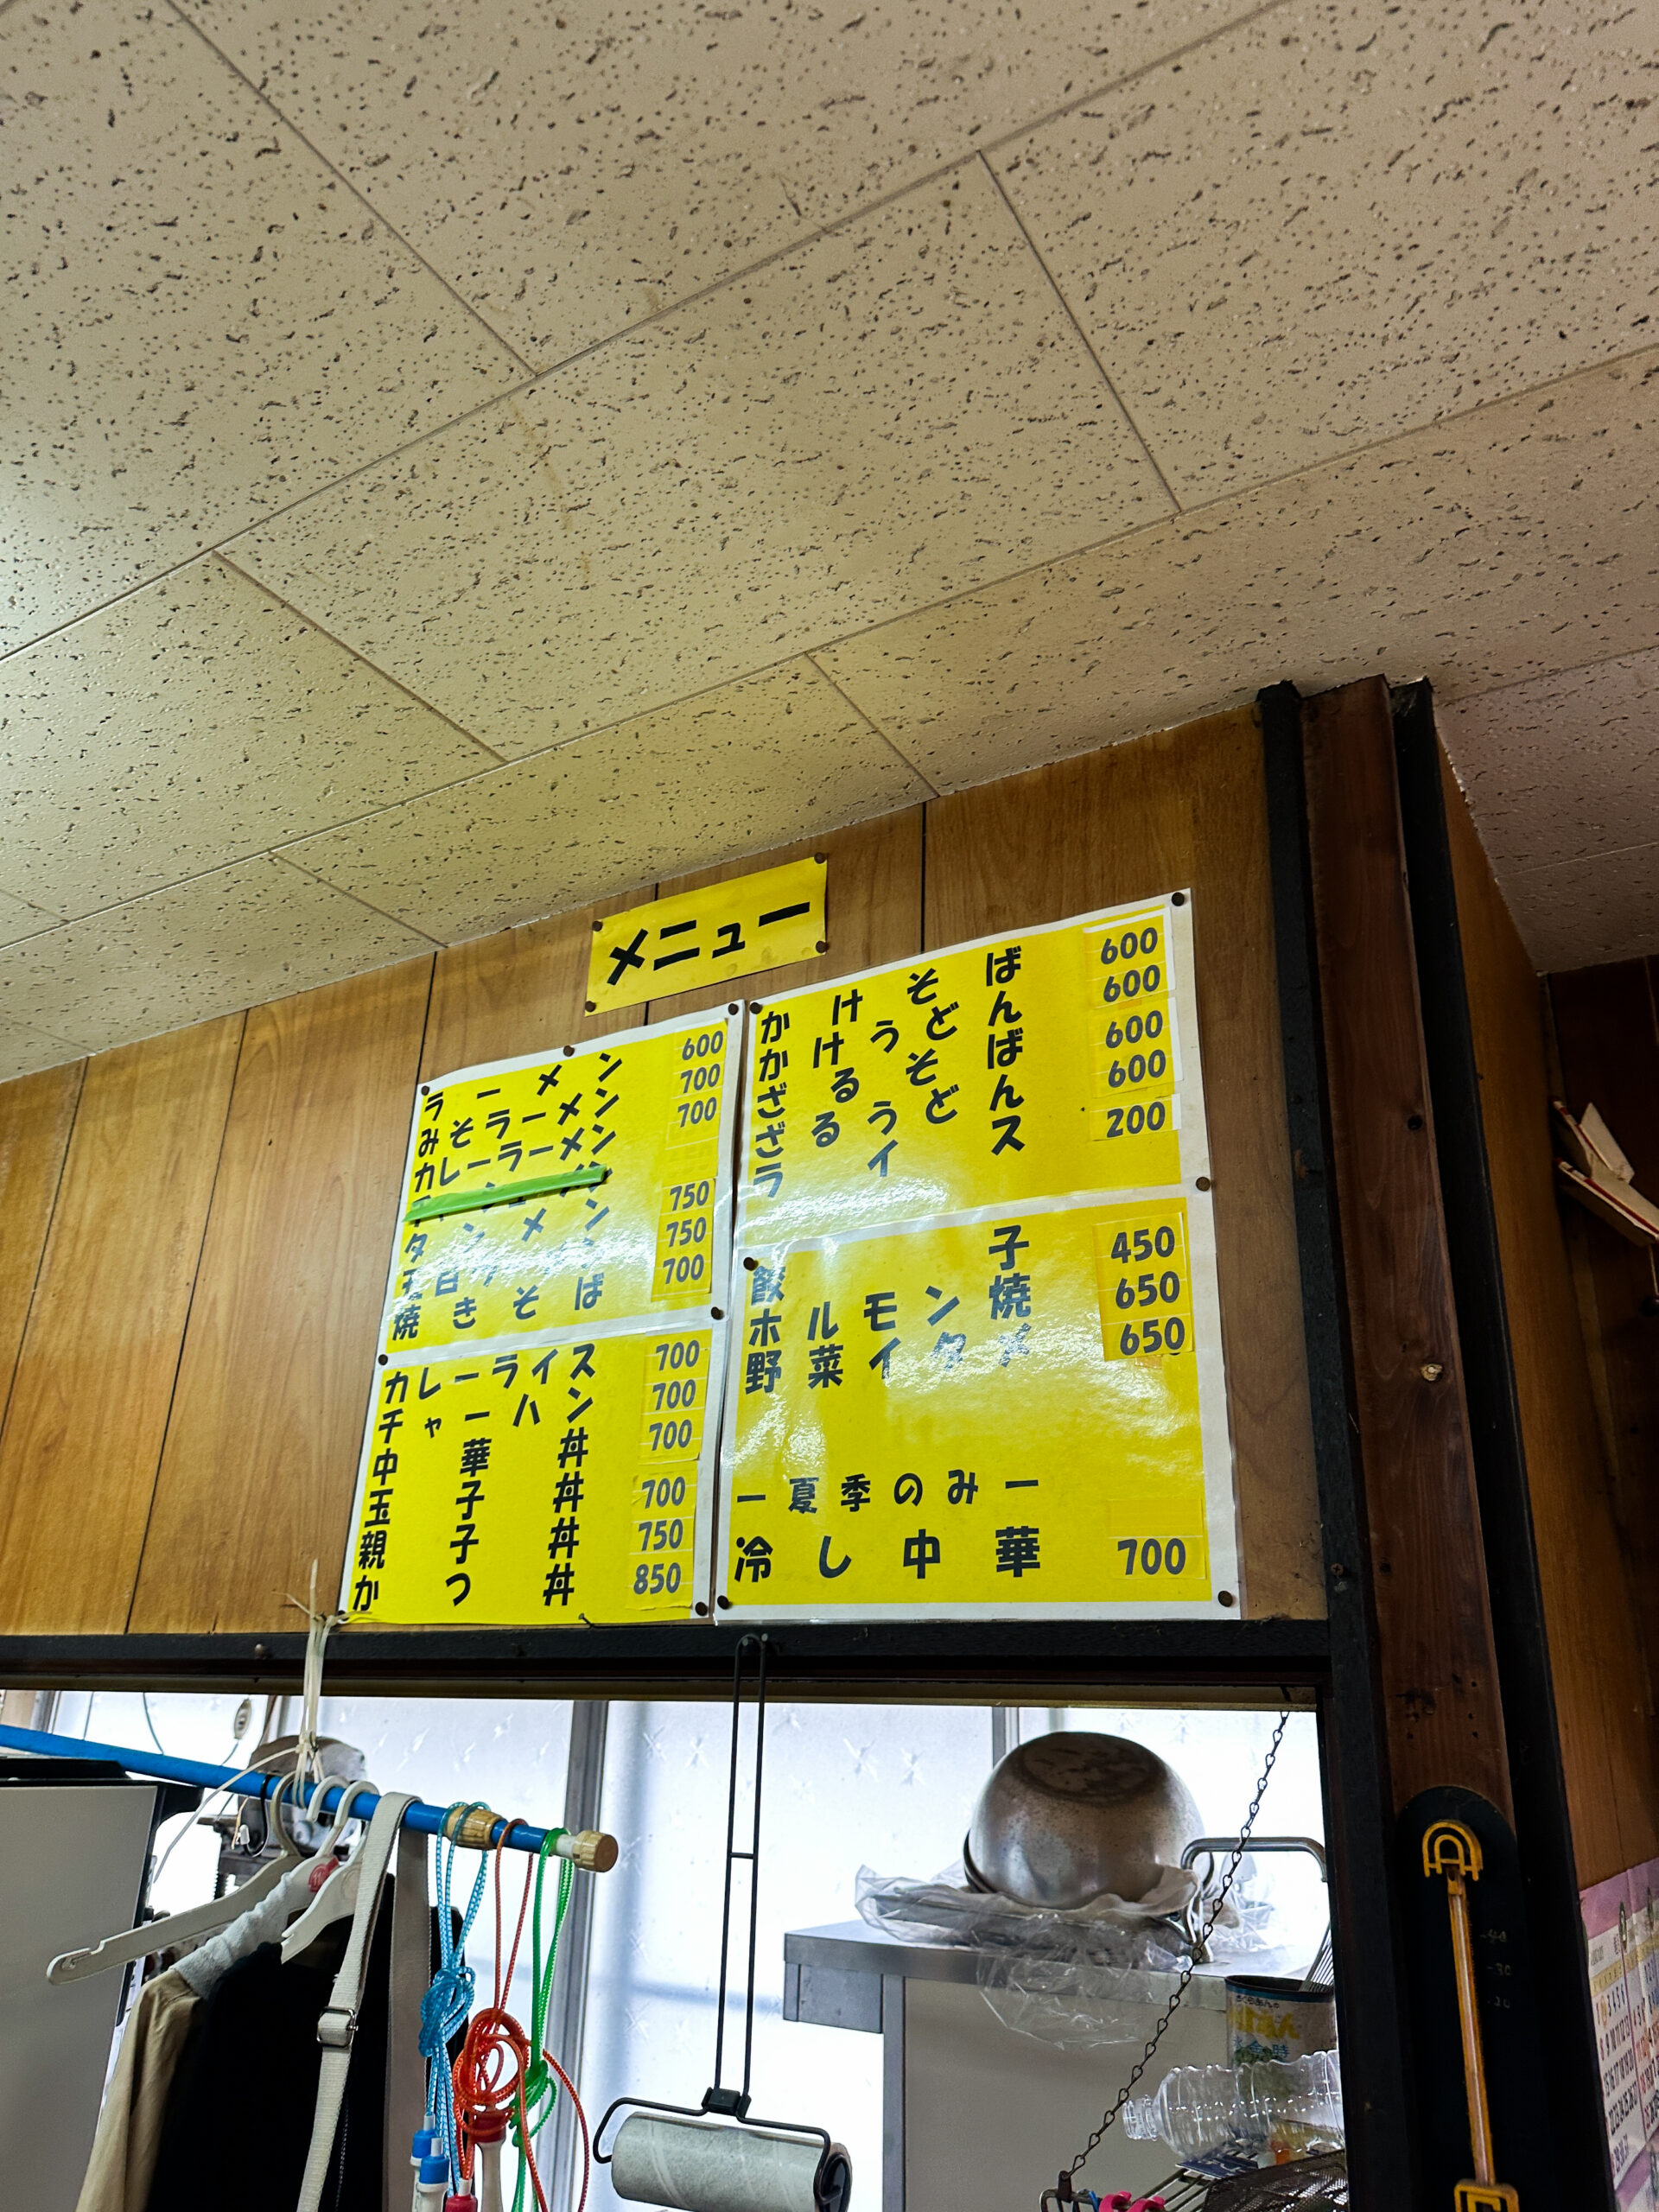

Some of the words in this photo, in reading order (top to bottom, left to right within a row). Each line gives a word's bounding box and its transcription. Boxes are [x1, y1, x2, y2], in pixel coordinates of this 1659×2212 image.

[607, 901, 810, 986] メニュー
[759, 990, 1023, 1084] かけうどん
[1103, 963, 1161, 1003] 600
[760, 946, 1022, 1045] かけそば
[1100, 926, 1159, 966] 600
[424, 1052, 622, 1121] ラーメン
[682, 1030, 724, 1062] 600
[757, 1026, 1024, 1120] ざるそば
[1104, 1009, 1164, 1049] 600
[418, 1087, 620, 1157] みそラーメン
[680, 1064, 721, 1095] 700
[754, 1074, 1025, 1160] ざるうどん
[1108, 1049, 1166, 1089] 600
[415, 1124, 616, 1193] カレーラーメン
[677, 1096, 717, 1128] 700
[753, 1114, 1026, 1198] ライス
[1105, 1101, 1166, 1139] 200
[666, 1216, 707, 1248] 750
[669, 1181, 709, 1212] 750
[1110, 1225, 1175, 1265] 450
[392, 1272, 605, 1341] 焼きそば
[663, 1254, 704, 1285] 700
[748, 1273, 1032, 1347] ホルモン焼
[1116, 1270, 1180, 1310] 650
[385, 1342, 596, 1404] カレーライス
[655, 1339, 700, 1372] 700
[744, 1323, 1031, 1395] 野菜イタメ
[1120, 1317, 1185, 1357] 650
[378, 1387, 594, 1445] チャーハン
[652, 1379, 696, 1411] 700
[372, 1427, 589, 1485] 中華丼
[648, 1418, 692, 1452] 700
[364, 1471, 584, 1529] 玉子丼
[641, 1476, 686, 1510] 700
[358, 1516, 580, 1571] 親子丼
[638, 1518, 683, 1551] 750
[734, 1526, 1041, 1583] 冷し中華
[1117, 1538, 1186, 1576] 700
[353, 1562, 575, 1612] かつ丼
[633, 1561, 681, 1594] 850
